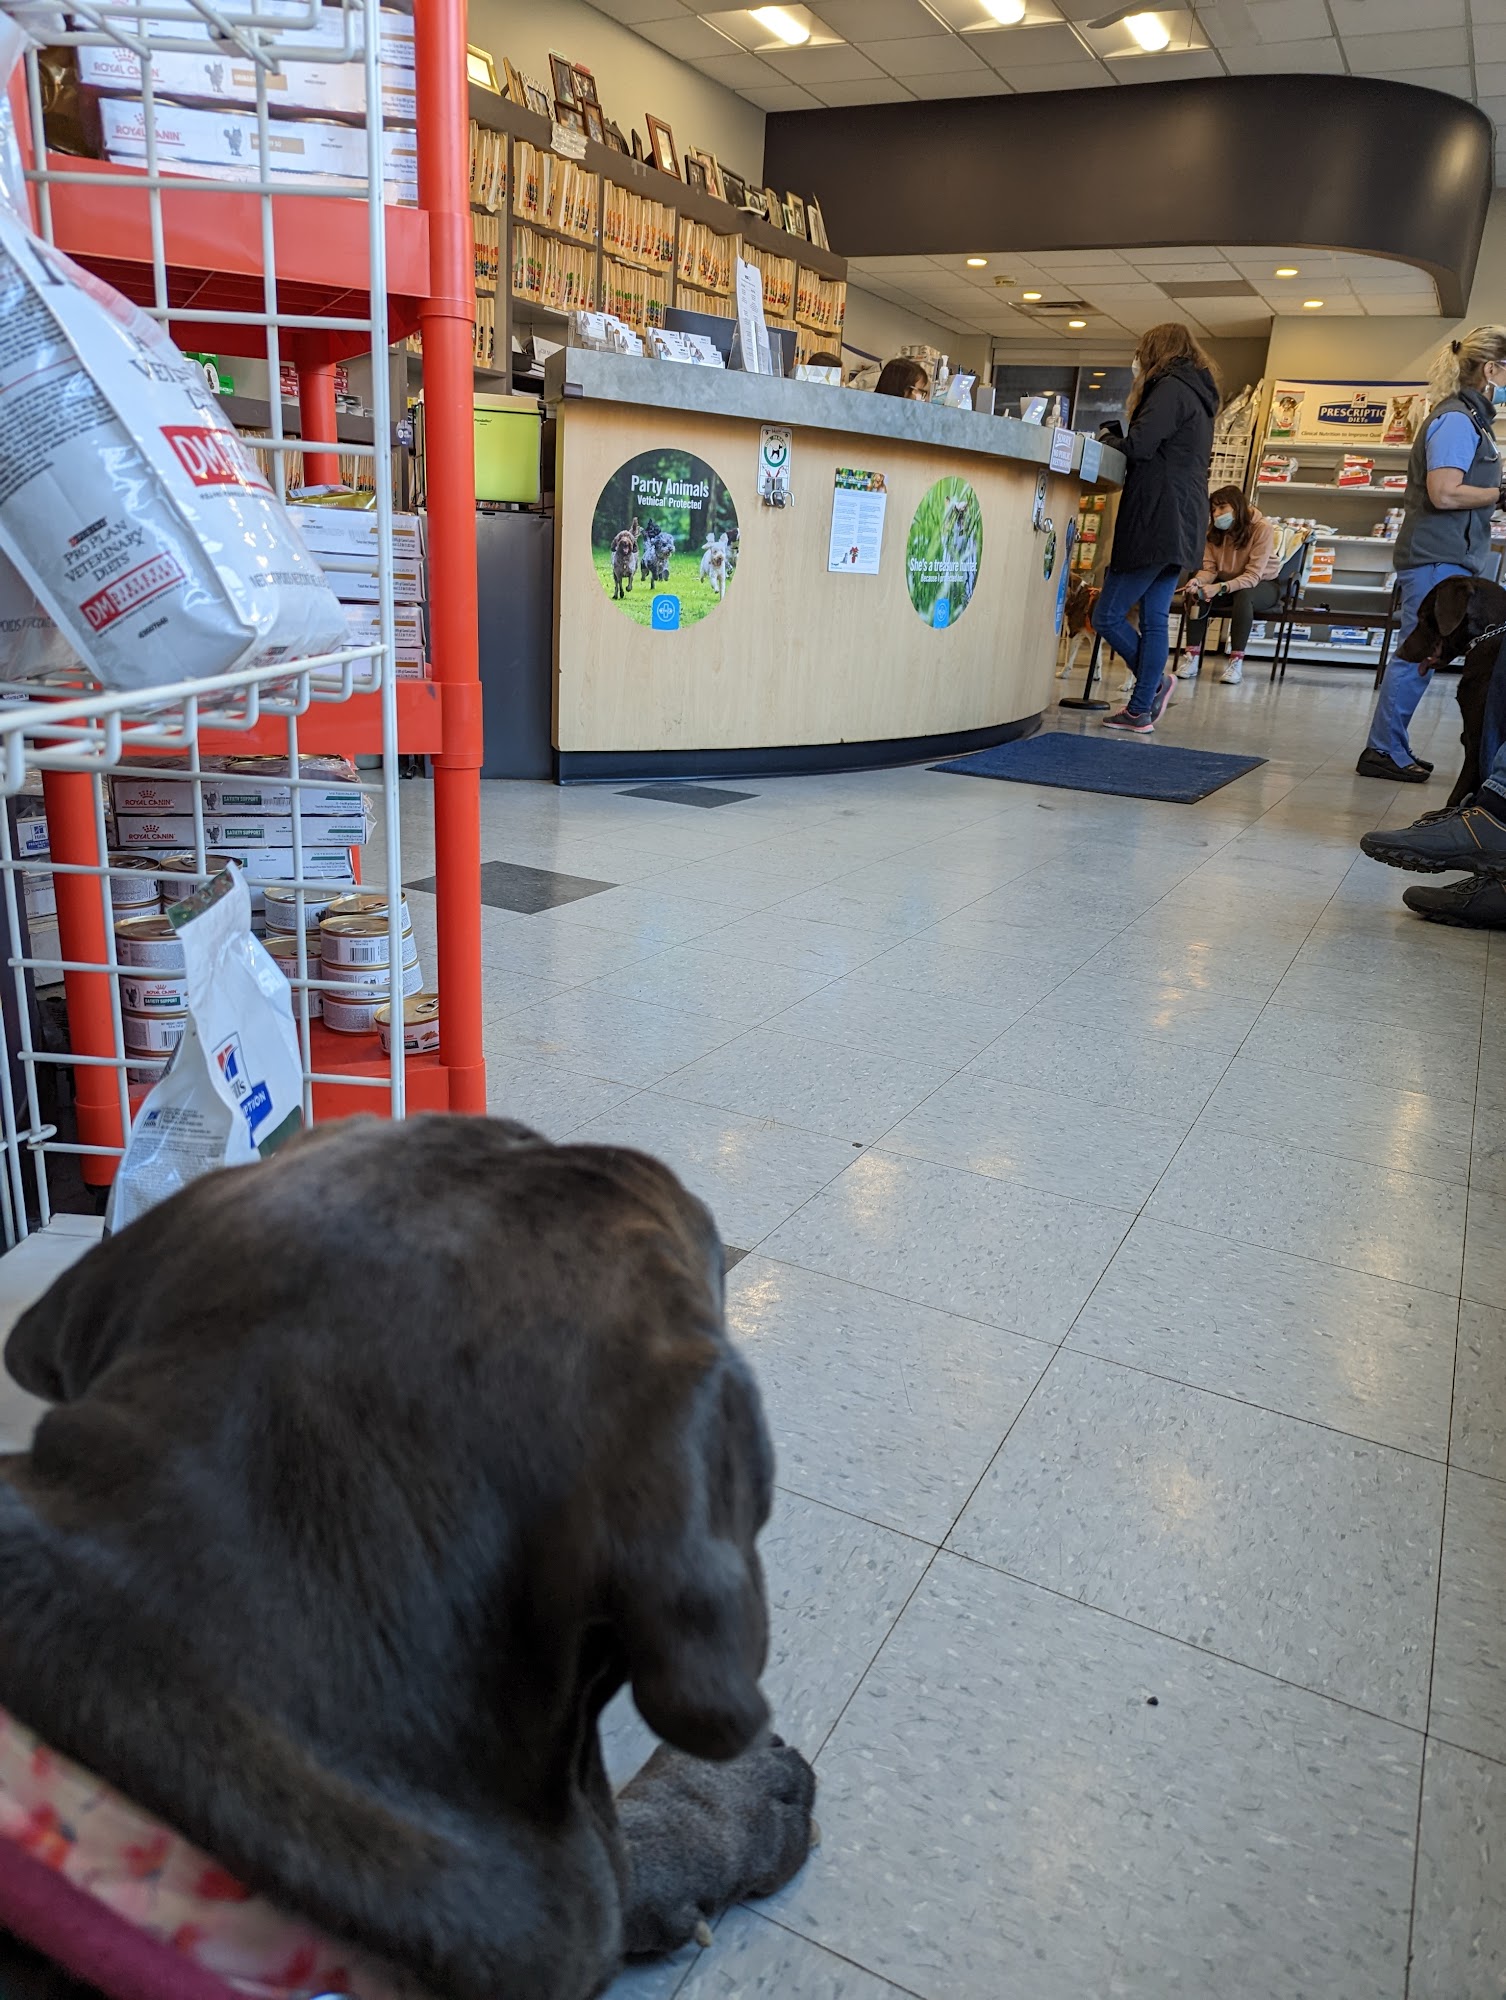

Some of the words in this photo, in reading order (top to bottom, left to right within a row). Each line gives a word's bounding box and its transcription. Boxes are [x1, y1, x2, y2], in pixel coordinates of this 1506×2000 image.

[94, 62, 125, 75] ROYAL
[115, 125, 147, 137] ROYAL
[154, 131, 180, 142] ANIN
[1056, 433, 1073, 447] SORRY
[631, 475, 662, 496] Party
[665, 479, 709, 498] Animals
[637, 495, 666, 507] Vethical
[668, 498, 702, 510] Protected
[64, 542, 91, 566] PRO
[89, 520, 128, 549] PLAN
[64, 527, 145, 582] VETERINARY
[910, 557, 928, 571] She's
[928, 561, 933, 571] a
[934, 560, 959, 571] treasure
[92, 552, 131, 581] DIETS
[85, 596, 117, 626] DM
